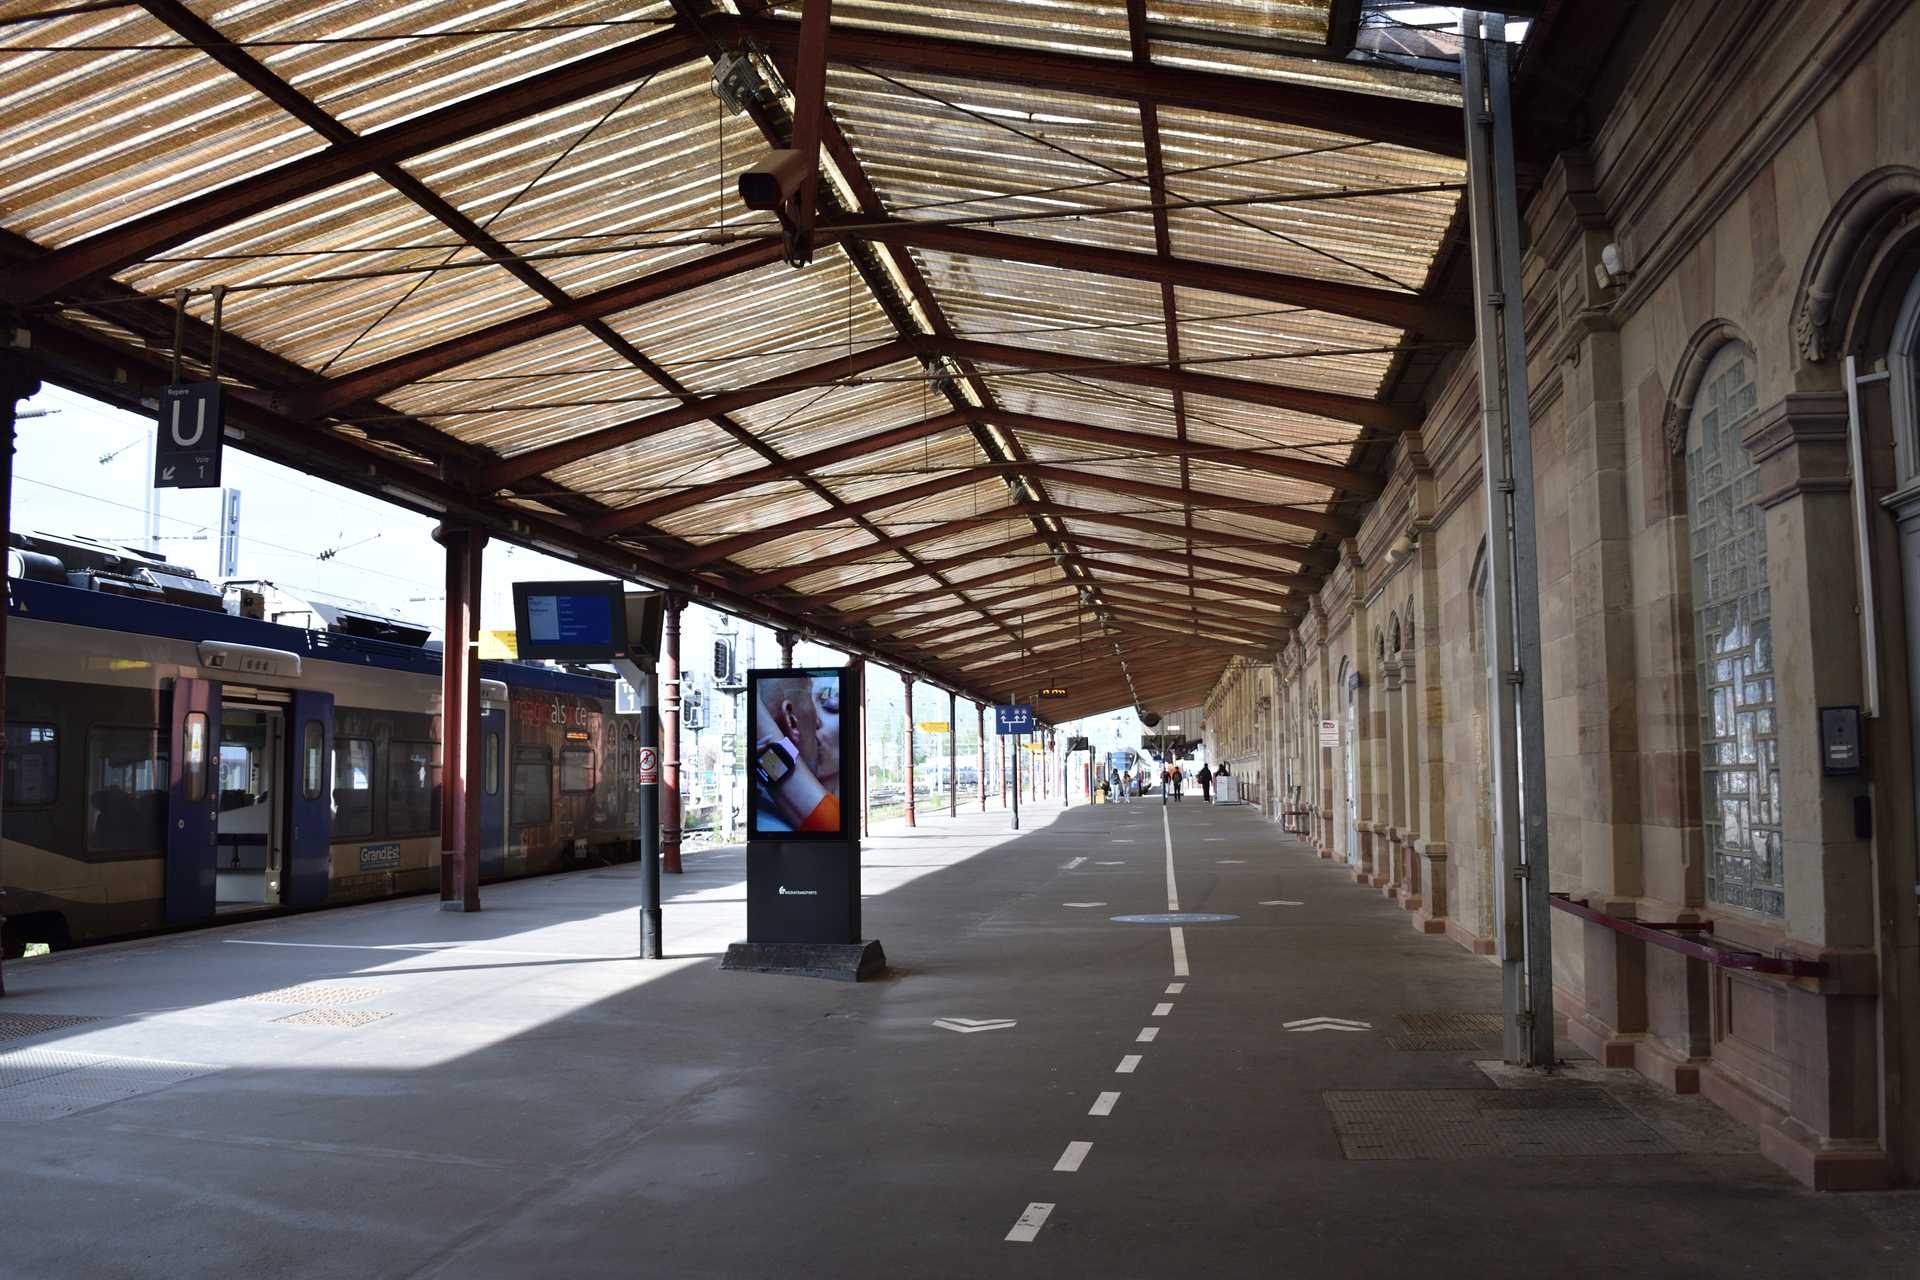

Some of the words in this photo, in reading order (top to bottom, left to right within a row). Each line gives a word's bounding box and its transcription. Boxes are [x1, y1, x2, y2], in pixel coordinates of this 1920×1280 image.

[172, 398, 205, 446] U
[198, 465, 204, 479] 1
[626, 694, 634, 711] 1
